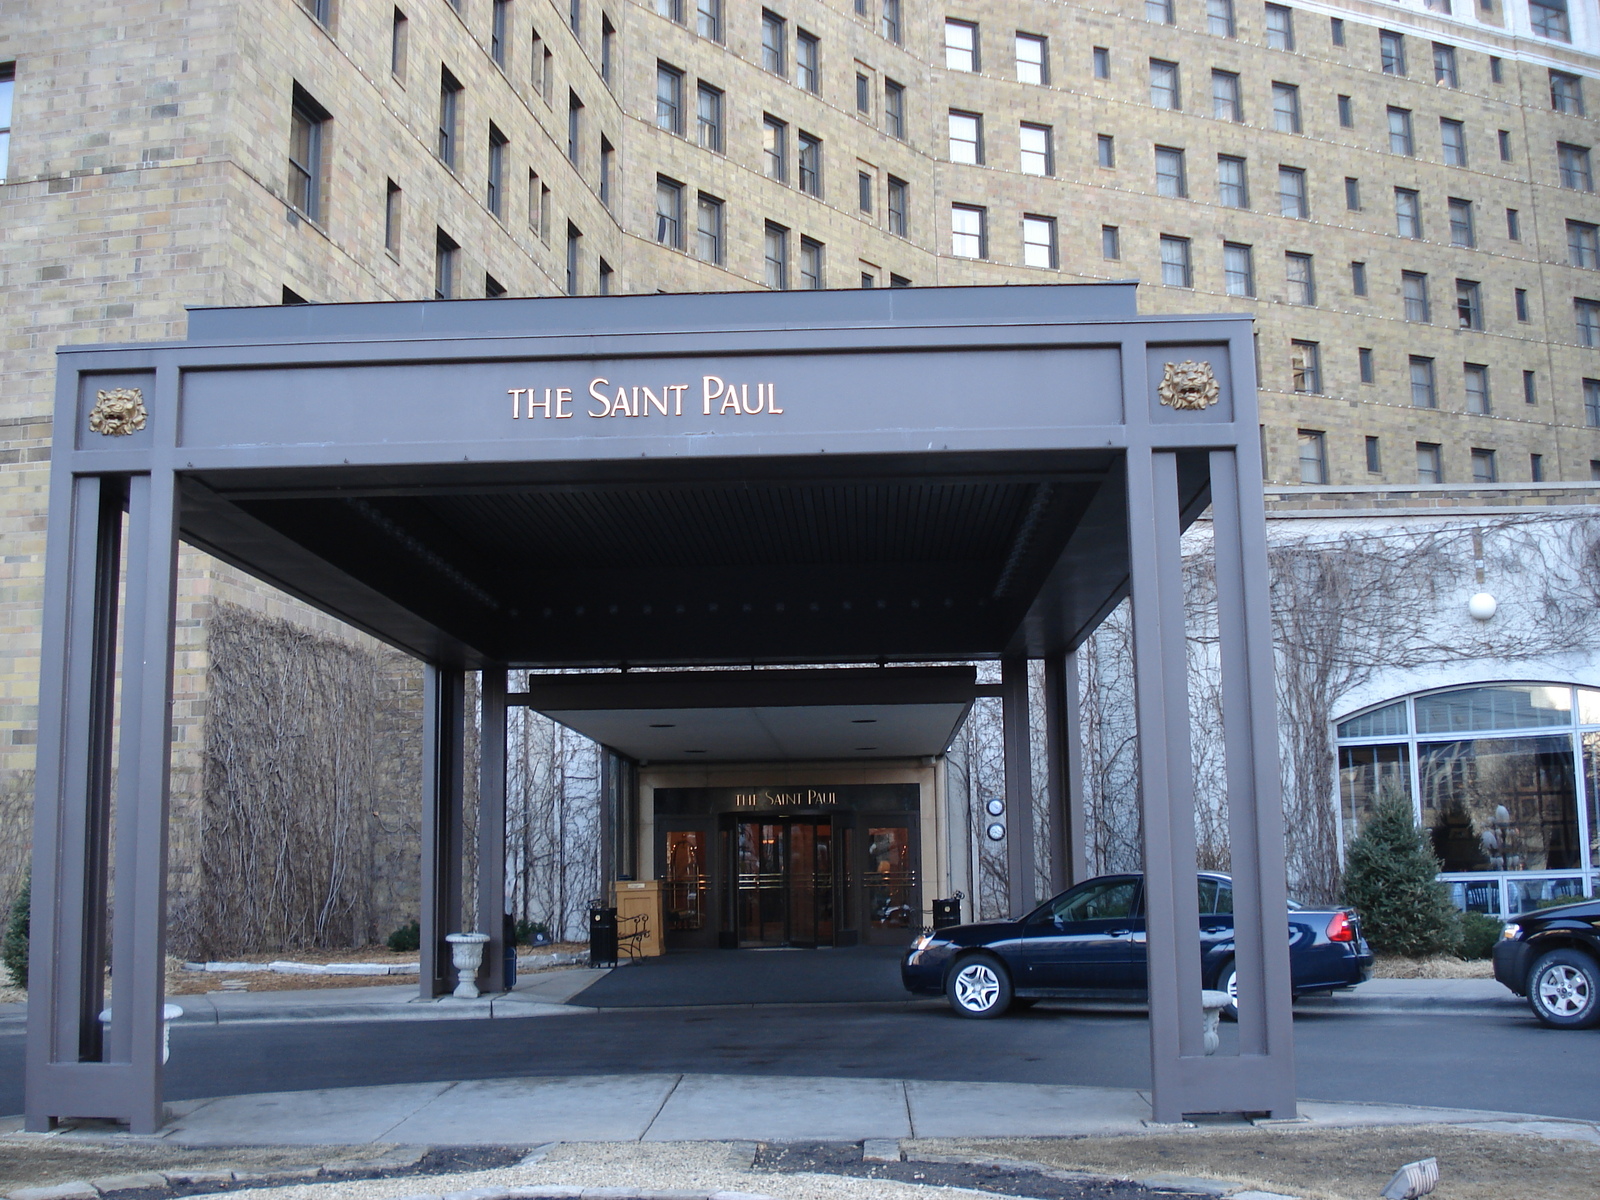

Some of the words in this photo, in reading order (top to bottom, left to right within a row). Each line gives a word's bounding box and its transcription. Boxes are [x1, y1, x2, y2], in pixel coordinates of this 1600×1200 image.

[507, 388, 573, 419] THE
[588, 377, 689, 418] SAINT
[702, 375, 784, 415] PAUL
[735, 794, 756, 806] THE
[765, 789, 803, 806] SAINT
[808, 789, 838, 805] PAUL
